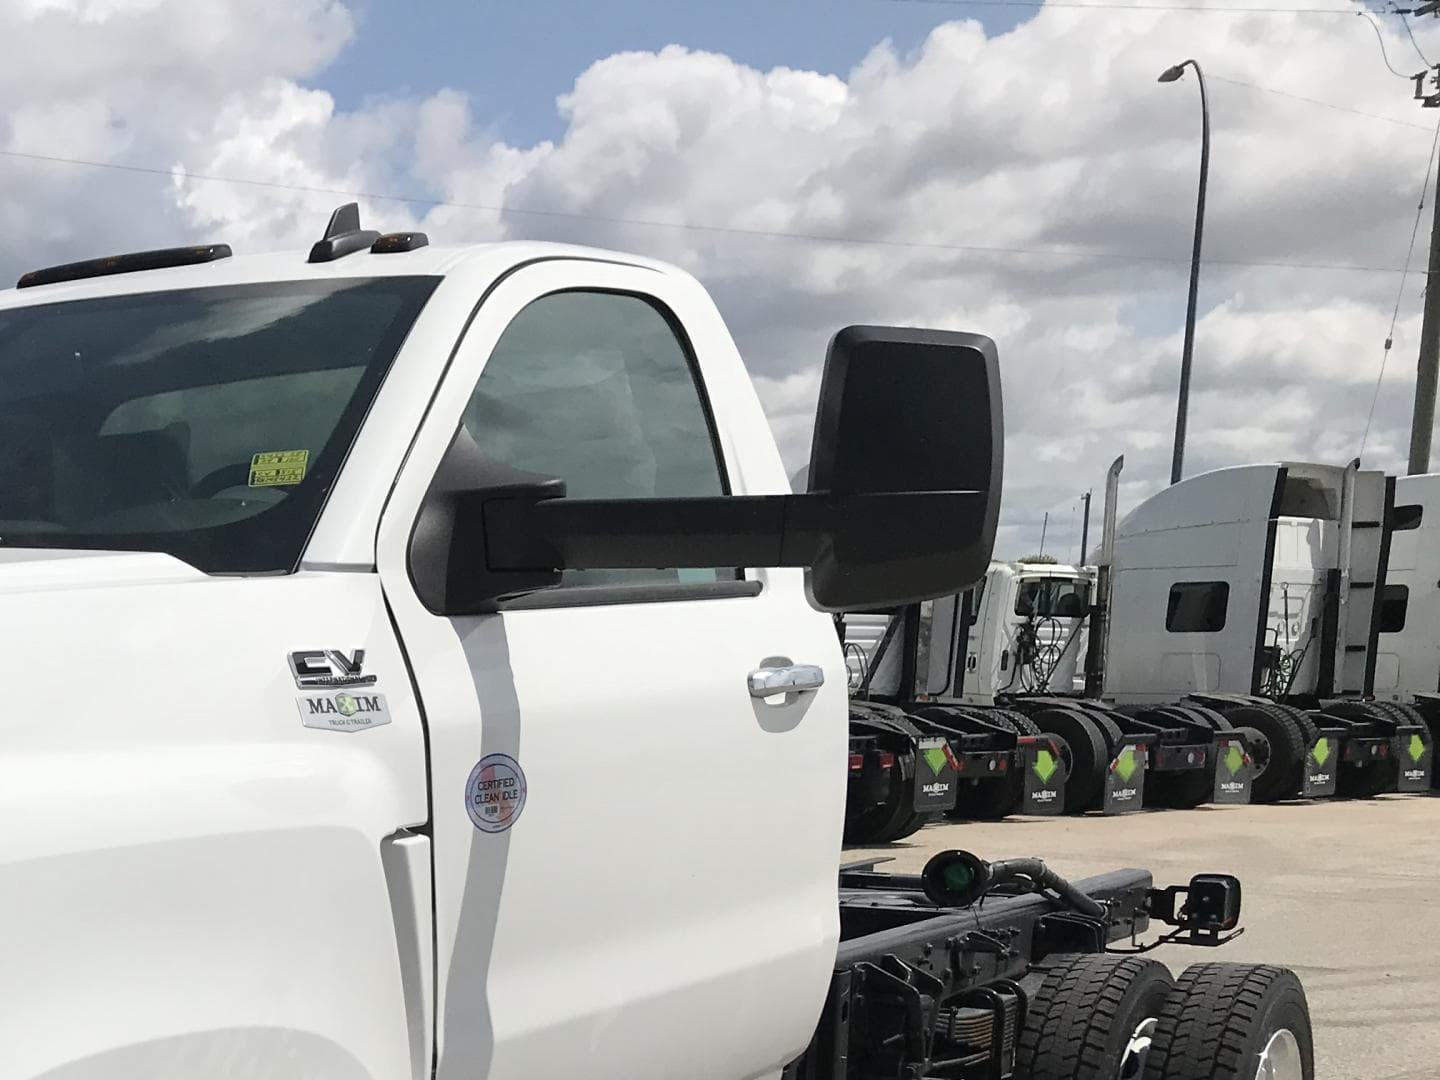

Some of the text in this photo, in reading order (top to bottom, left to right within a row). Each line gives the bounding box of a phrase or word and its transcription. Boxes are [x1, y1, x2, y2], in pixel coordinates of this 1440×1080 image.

[286, 649, 365, 677] CV
[306, 693, 382, 717] MAXIM
[477, 777, 515, 791] CERTIFIED
[474, 789, 519, 805] CLEAN IDLE
